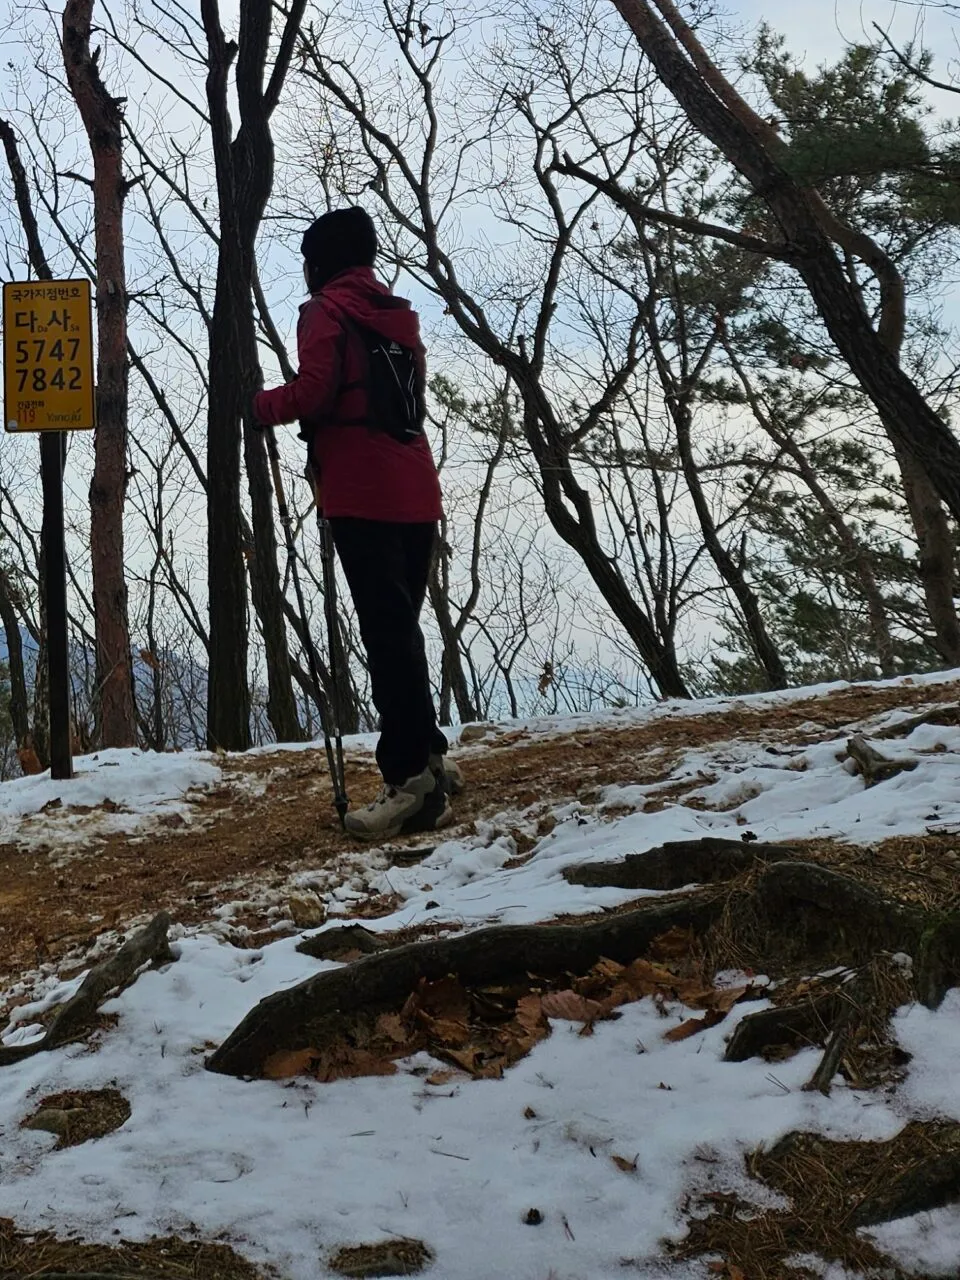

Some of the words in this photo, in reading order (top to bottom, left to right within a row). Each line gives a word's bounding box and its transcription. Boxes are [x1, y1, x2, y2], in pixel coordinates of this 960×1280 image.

[11, 287, 81, 303] 국가지점번호
[15, 309, 38, 333] 다
[47, 308, 71, 332] 사
[15, 338, 80, 364] 5747
[15, 366, 82, 393] 7842
[17, 409, 36, 424] 119
